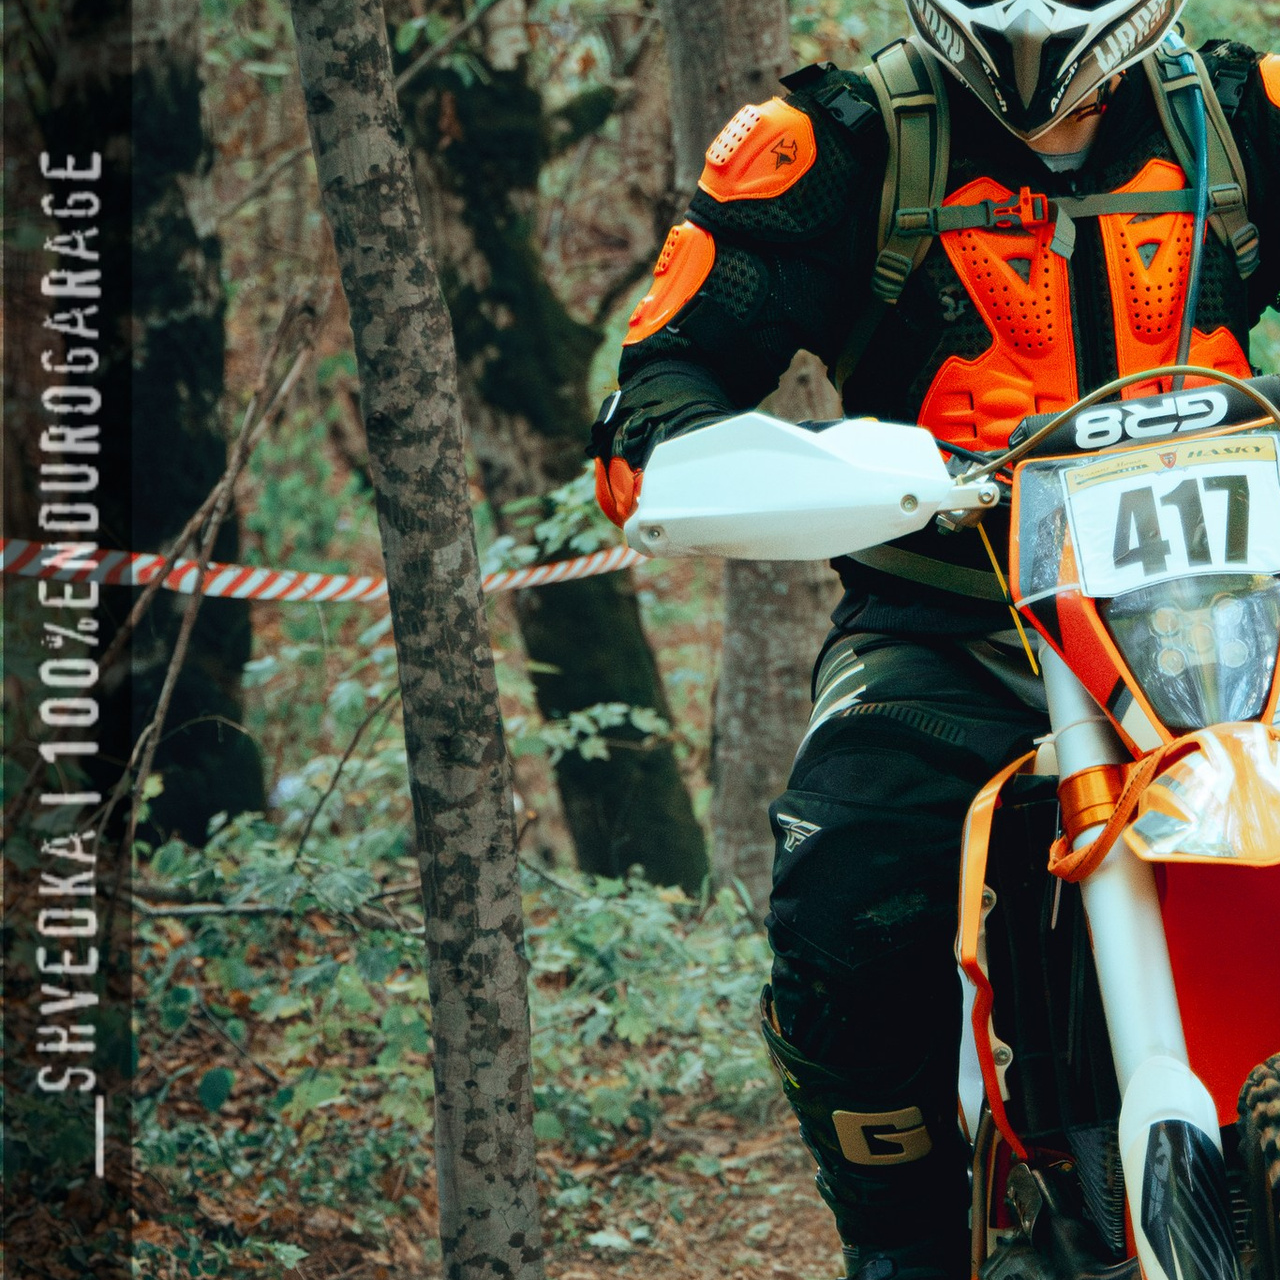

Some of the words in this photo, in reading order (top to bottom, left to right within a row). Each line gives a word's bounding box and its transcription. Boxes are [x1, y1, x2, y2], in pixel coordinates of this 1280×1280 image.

[1050, 60, 1080, 114] Airoh
[1075, 390, 1229, 449] GR8
[1112, 474, 1250, 578] 417
[832, 1105, 933, 1166] G
